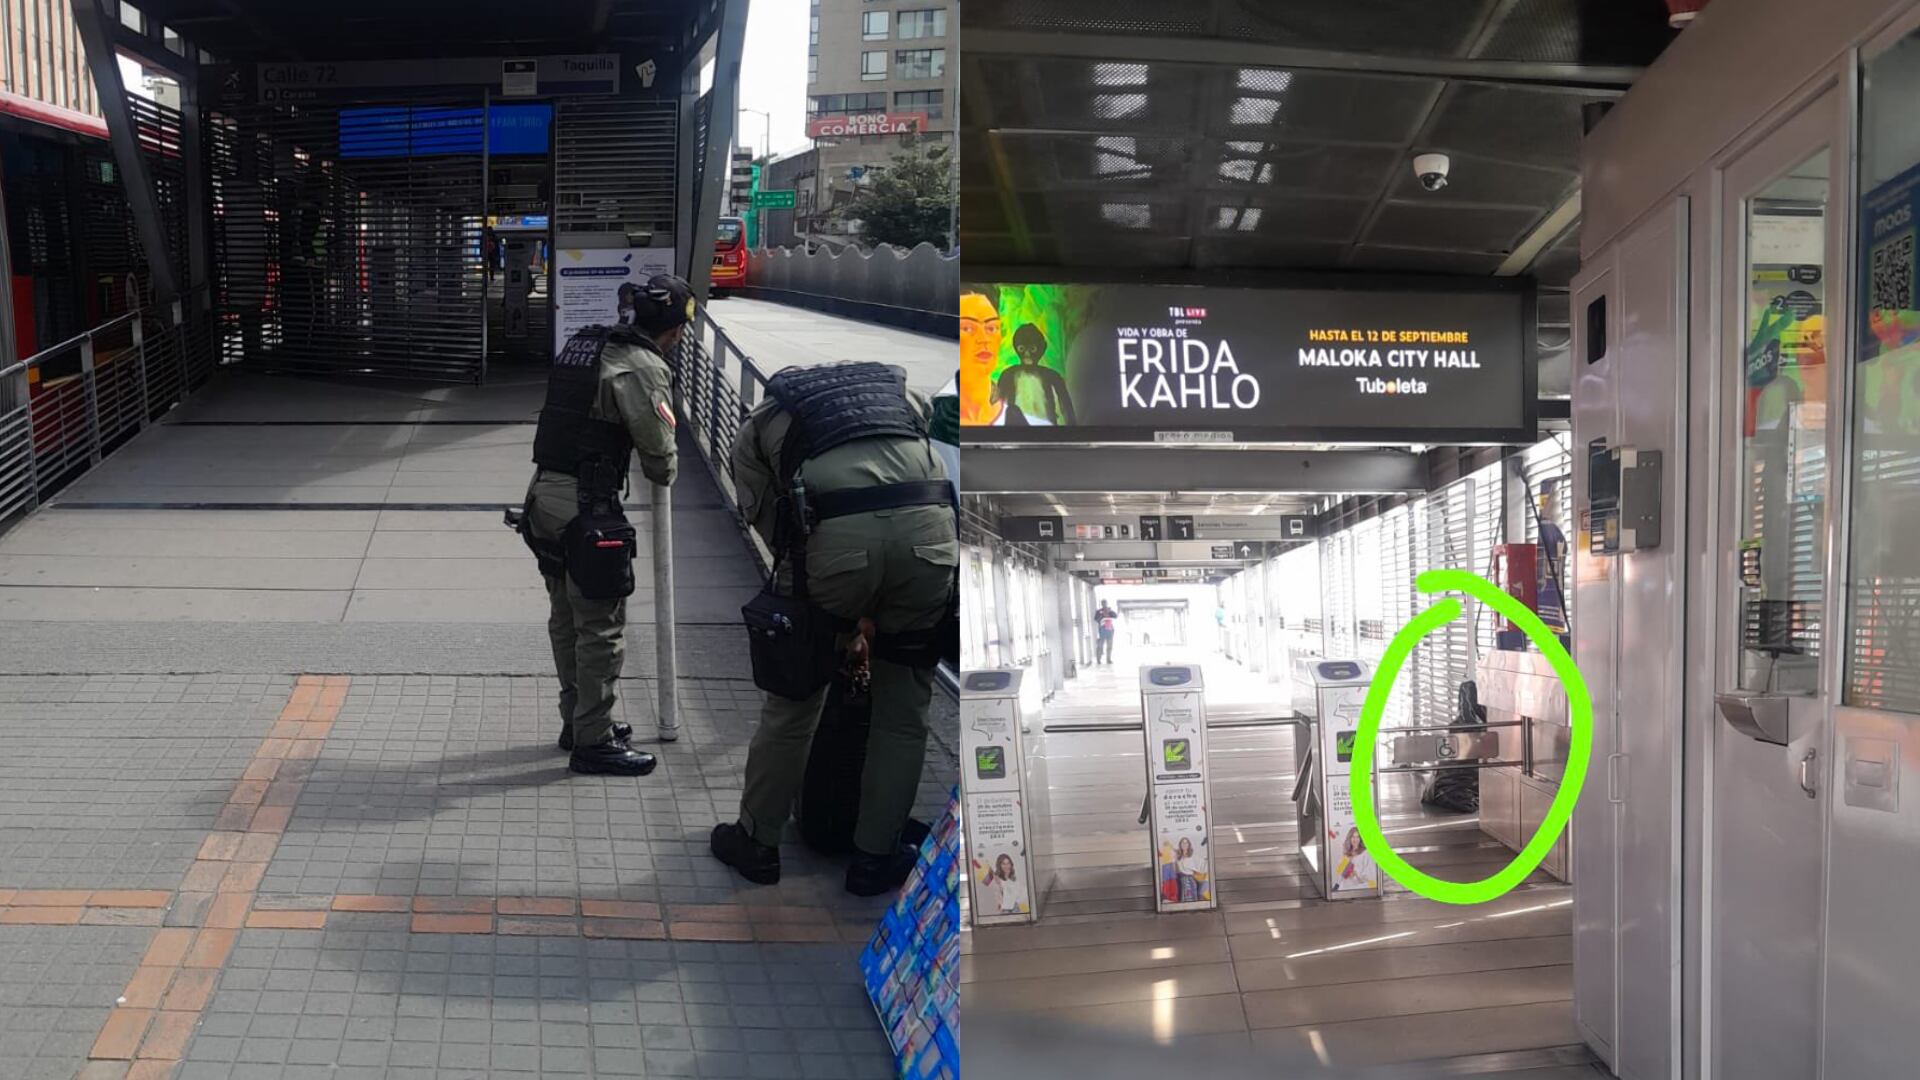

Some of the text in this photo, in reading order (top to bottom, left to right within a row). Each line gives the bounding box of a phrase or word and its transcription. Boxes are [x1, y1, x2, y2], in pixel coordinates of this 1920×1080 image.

[563, 58, 614, 73] Taquilla
[264, 64, 337, 83] Calle 72
[848, 114, 887, 125] BONO
[1790, 269, 1796, 279] 1
[1776, 298, 1783, 310] 2
[1169, 307, 1207, 317] TBL LIVE
[1117, 328, 1188, 338] VIDA Y OBRA DE
[1310, 329, 1469, 343] HASTA EL 12 DE SEPTIEMBRE
[566, 339, 600, 353] POLICIA
[1118, 338, 1240, 374] FRIDA
[1299, 348, 1481, 368] MALOKA CITY HALL
[1120, 373, 1261, 409] KAHLO
[1355, 377, 1428, 394] Tuboleta
[1147, 526, 1154, 538] 1
[1181, 526, 1188, 538] 1
